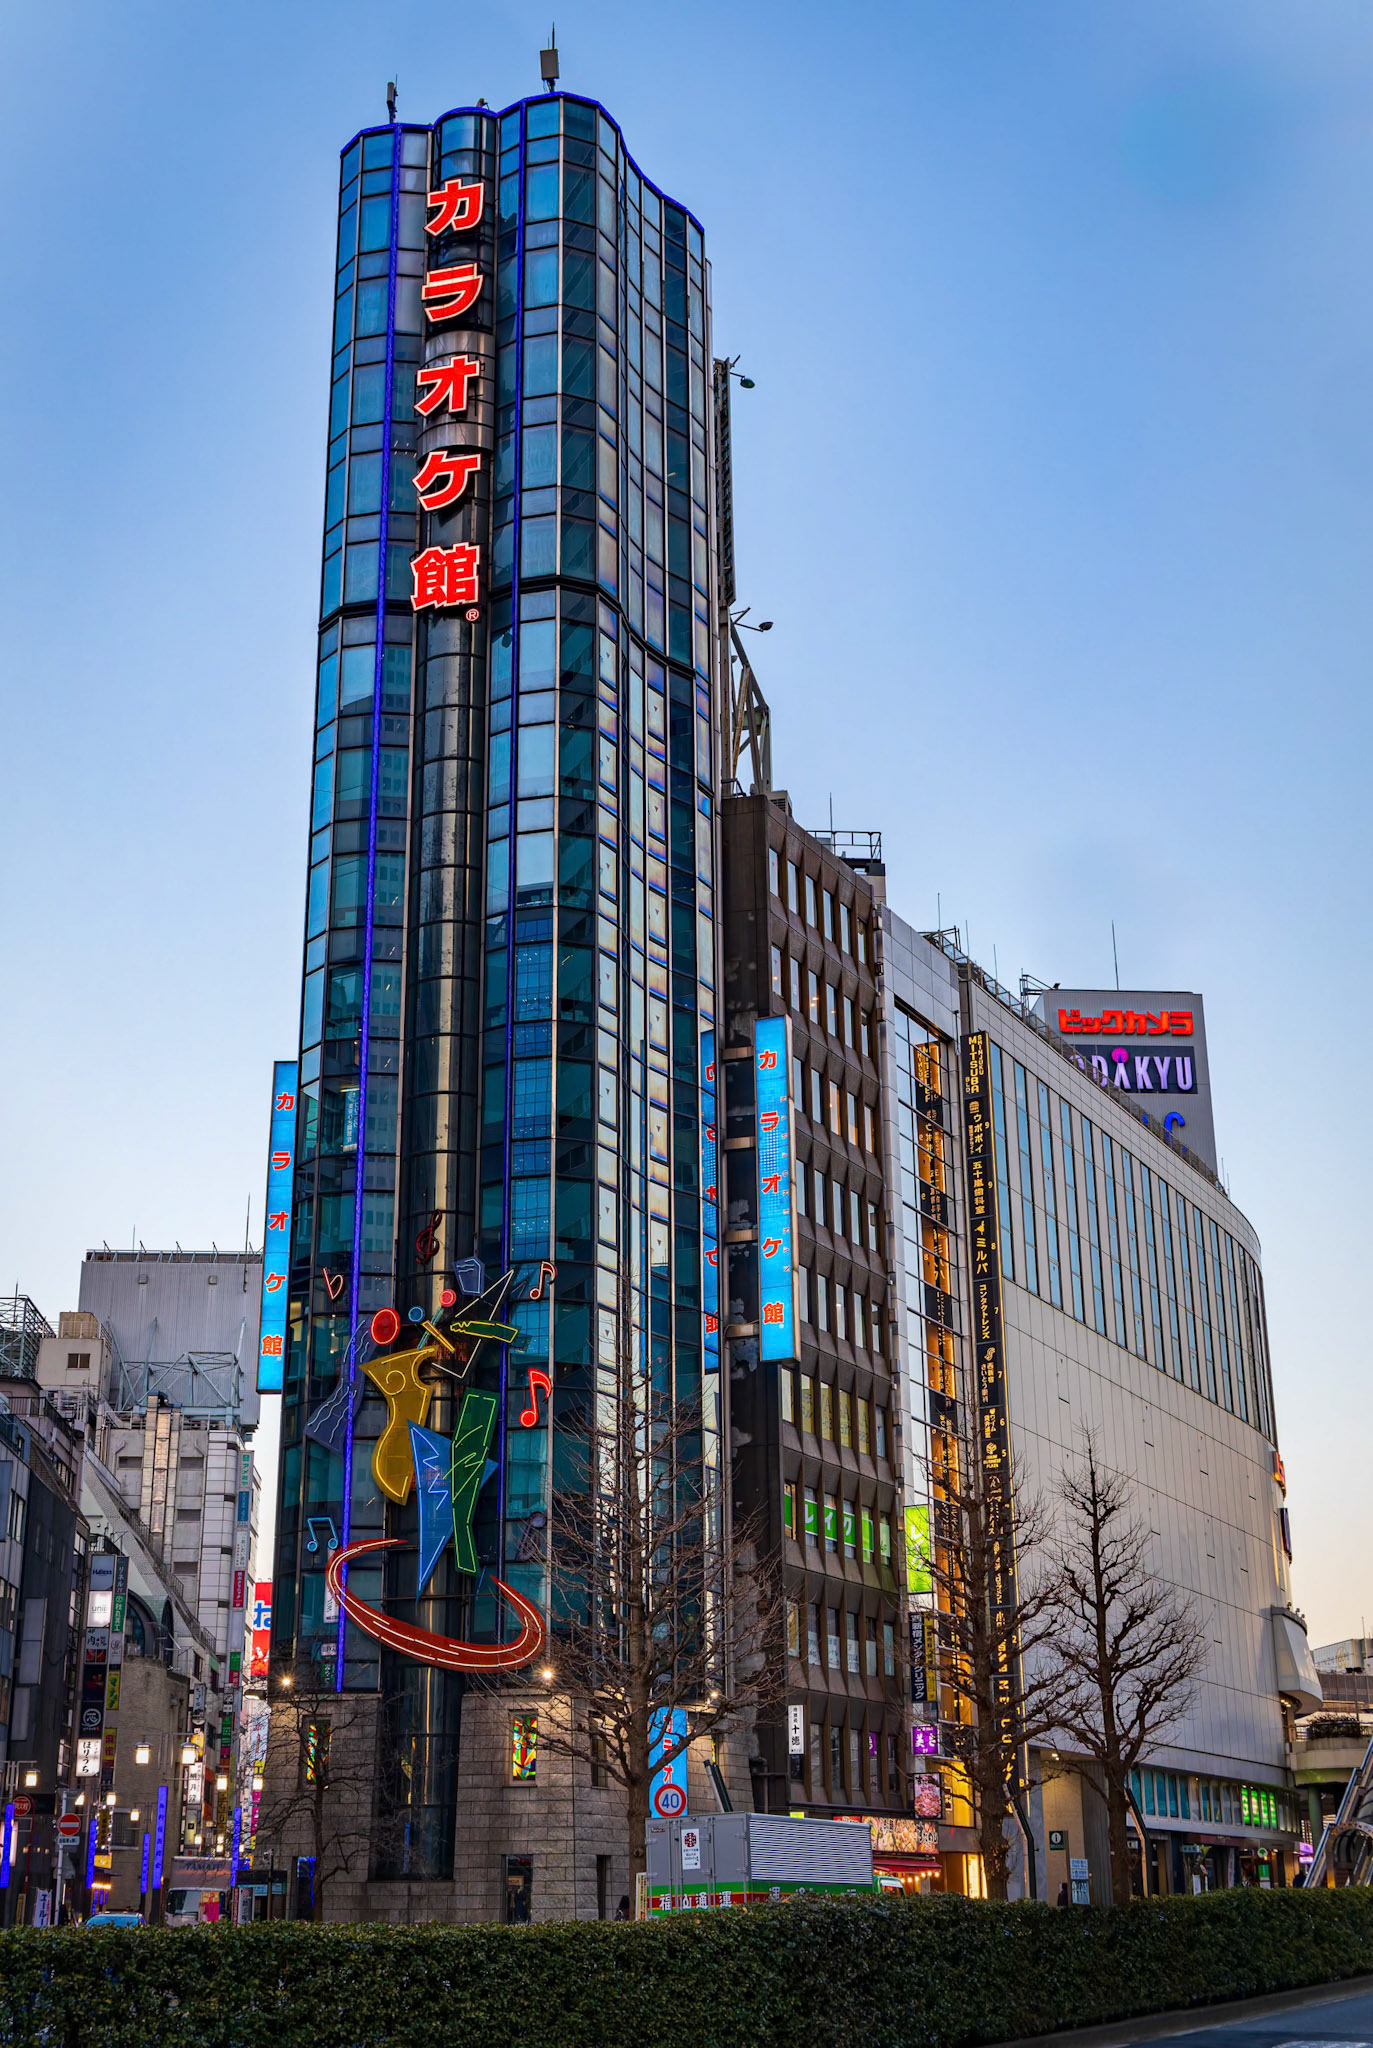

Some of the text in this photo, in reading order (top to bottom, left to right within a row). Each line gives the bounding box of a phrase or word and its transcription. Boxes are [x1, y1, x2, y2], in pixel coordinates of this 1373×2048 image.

[410, 178, 485, 611] カラオケ館
[1058, 1008, 1194, 1035] ビックカメラ
[968, 1036, 980, 1094] MITSUBA
[758, 1049, 785, 1325] カラオケ館
[261, 1092, 295, 1356] カラオケ館
[979, 1283, 990, 1340] コンタクトレンズ
[1000, 1417, 1006, 1427] 6
[1002, 1449, 1007, 1458] 5
[805, 1504, 852, 1536] レイク
[661, 1793, 680, 1809] 40
